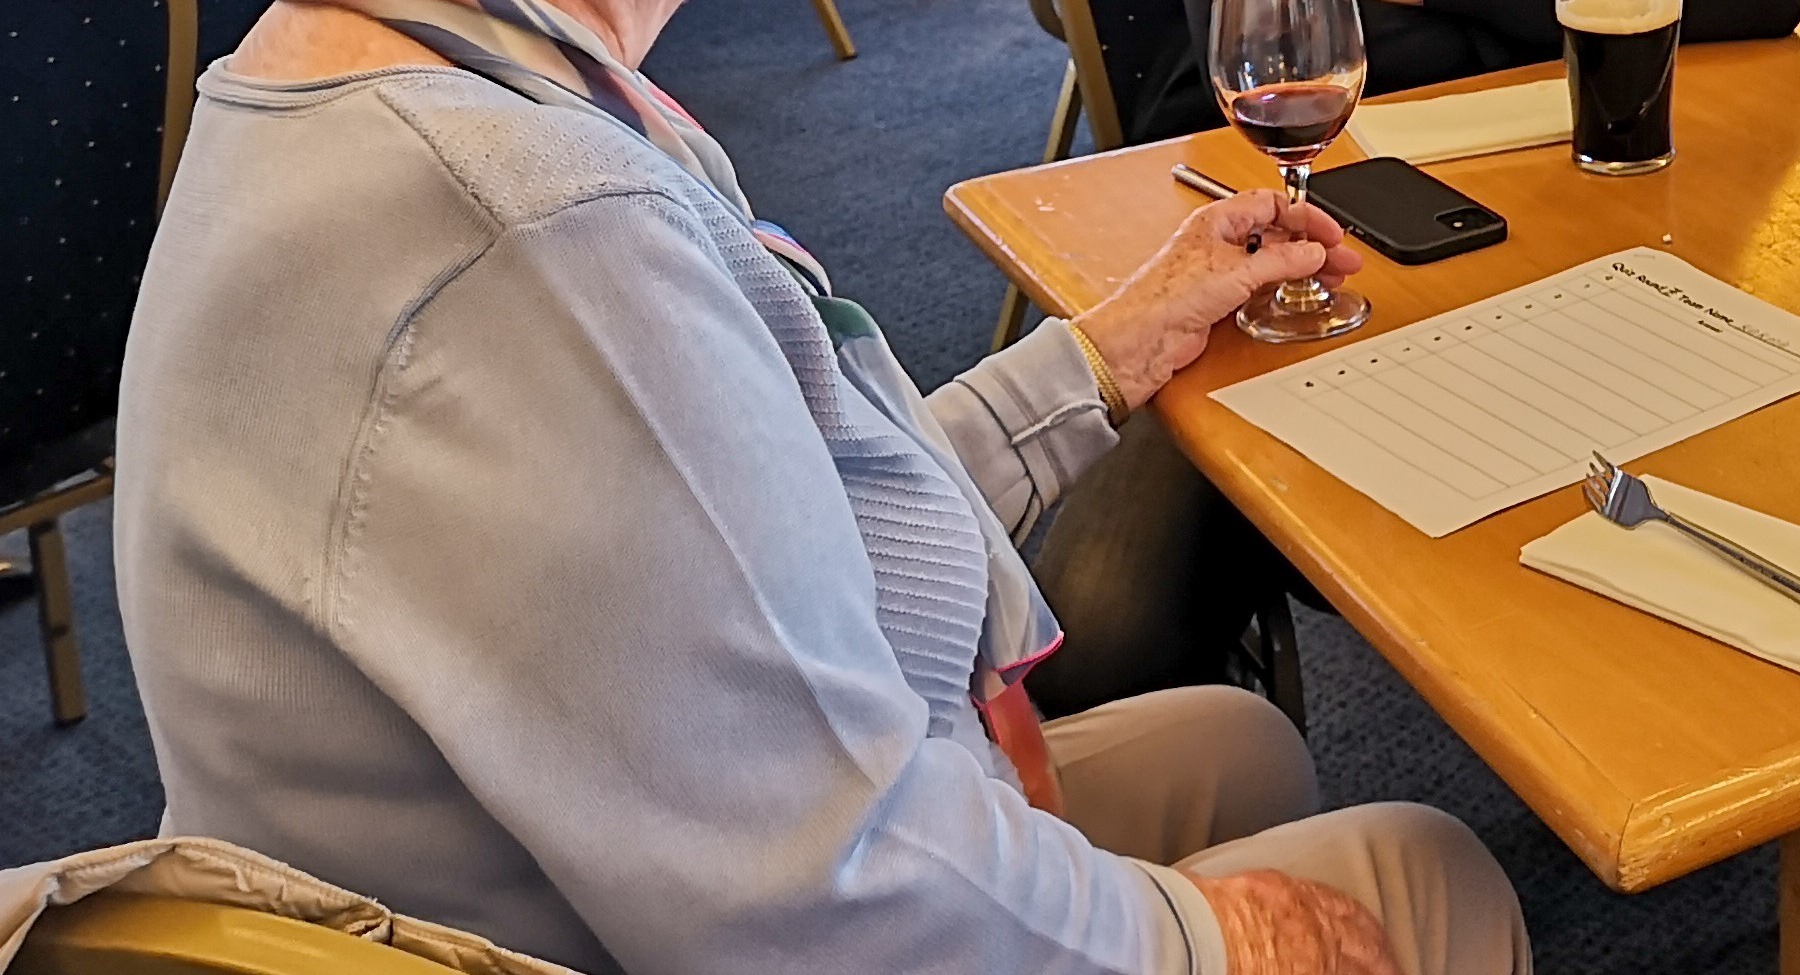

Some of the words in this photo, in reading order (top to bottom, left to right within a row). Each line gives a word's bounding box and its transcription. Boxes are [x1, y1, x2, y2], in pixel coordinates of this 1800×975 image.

[1612, 262, 1635, 276] Quiz
[1679, 294, 1704, 309] Team
[1704, 308, 1734, 324] Name
